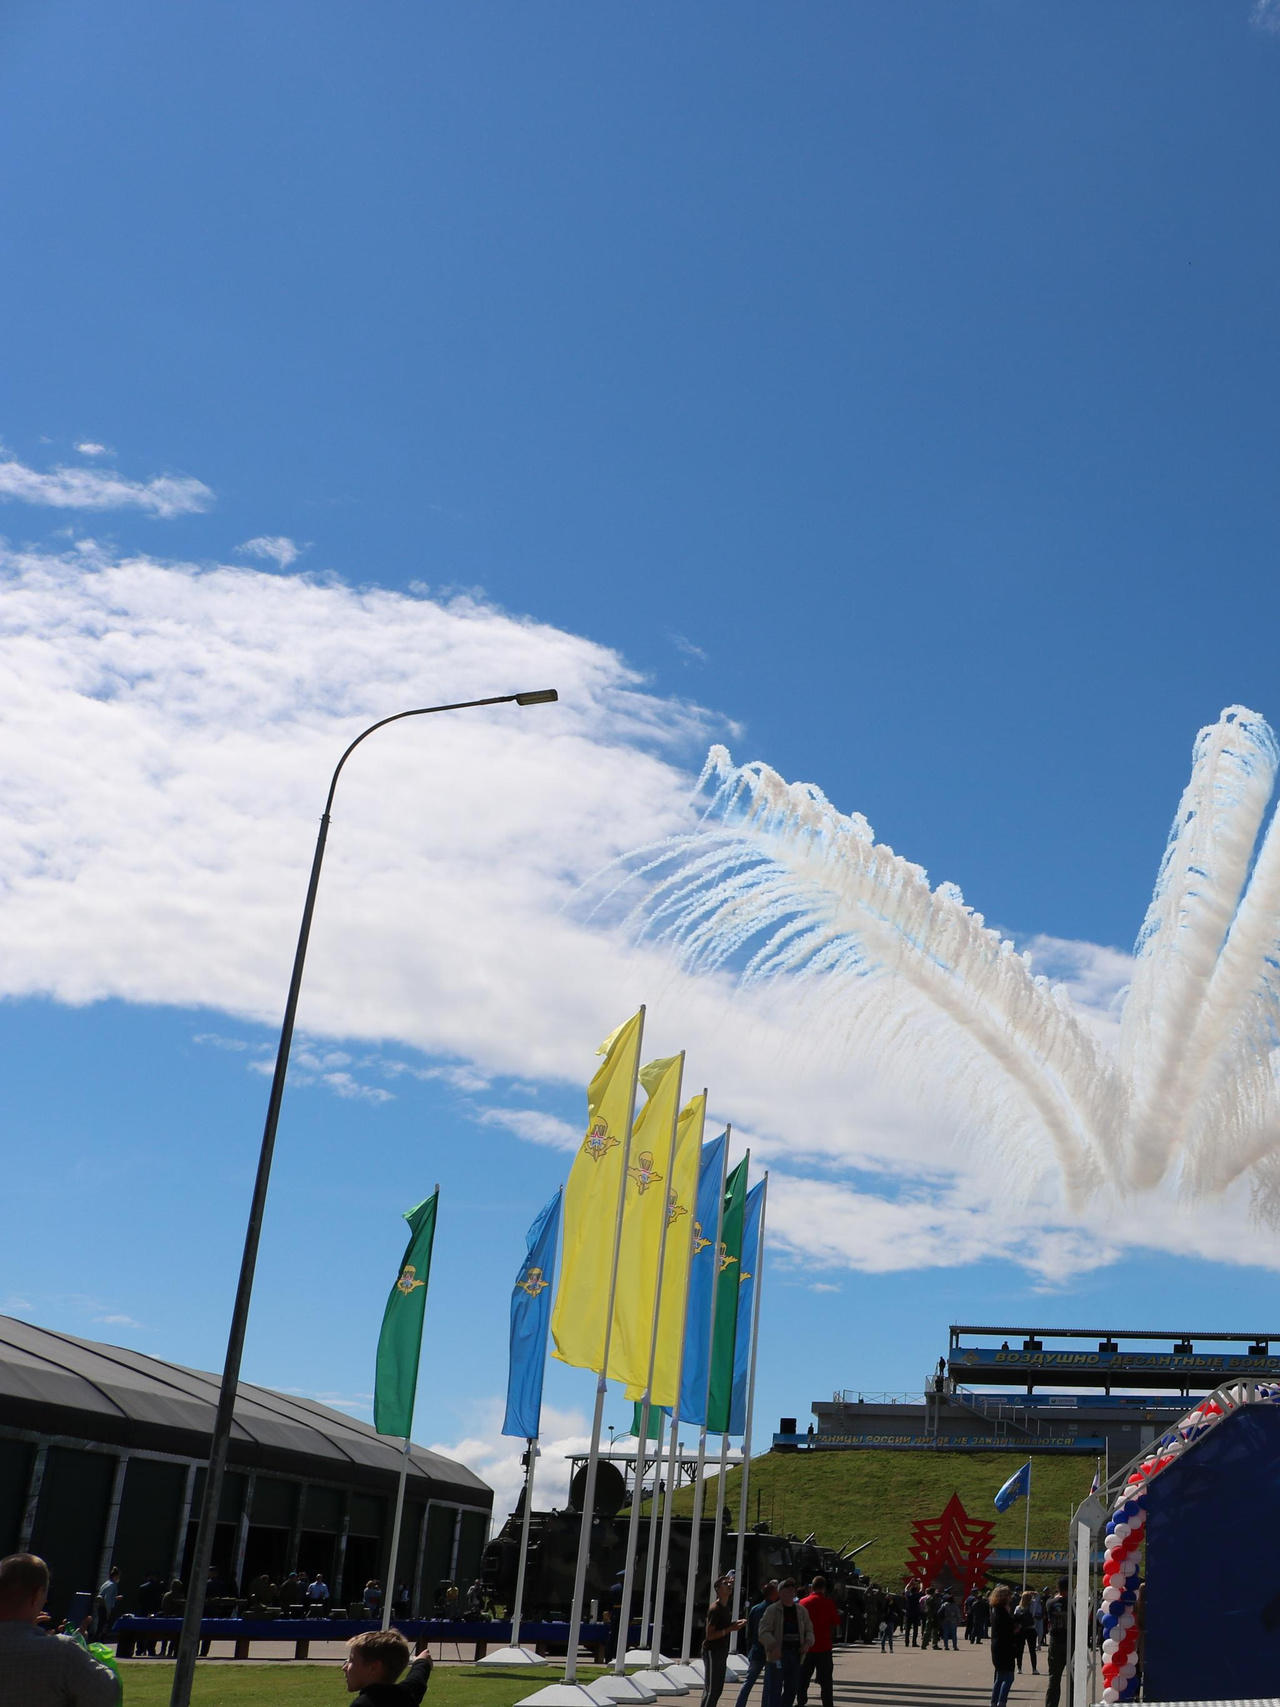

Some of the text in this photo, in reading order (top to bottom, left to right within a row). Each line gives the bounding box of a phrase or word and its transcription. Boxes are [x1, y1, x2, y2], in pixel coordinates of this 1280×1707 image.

[807, 1434, 863, 1445] ГРАНИЦЫ
[866, 1435, 911, 1445] РОССИИ
[914, 1436, 951, 1446] НИГДЕ
[953, 1436, 968, 1445] НЕ
